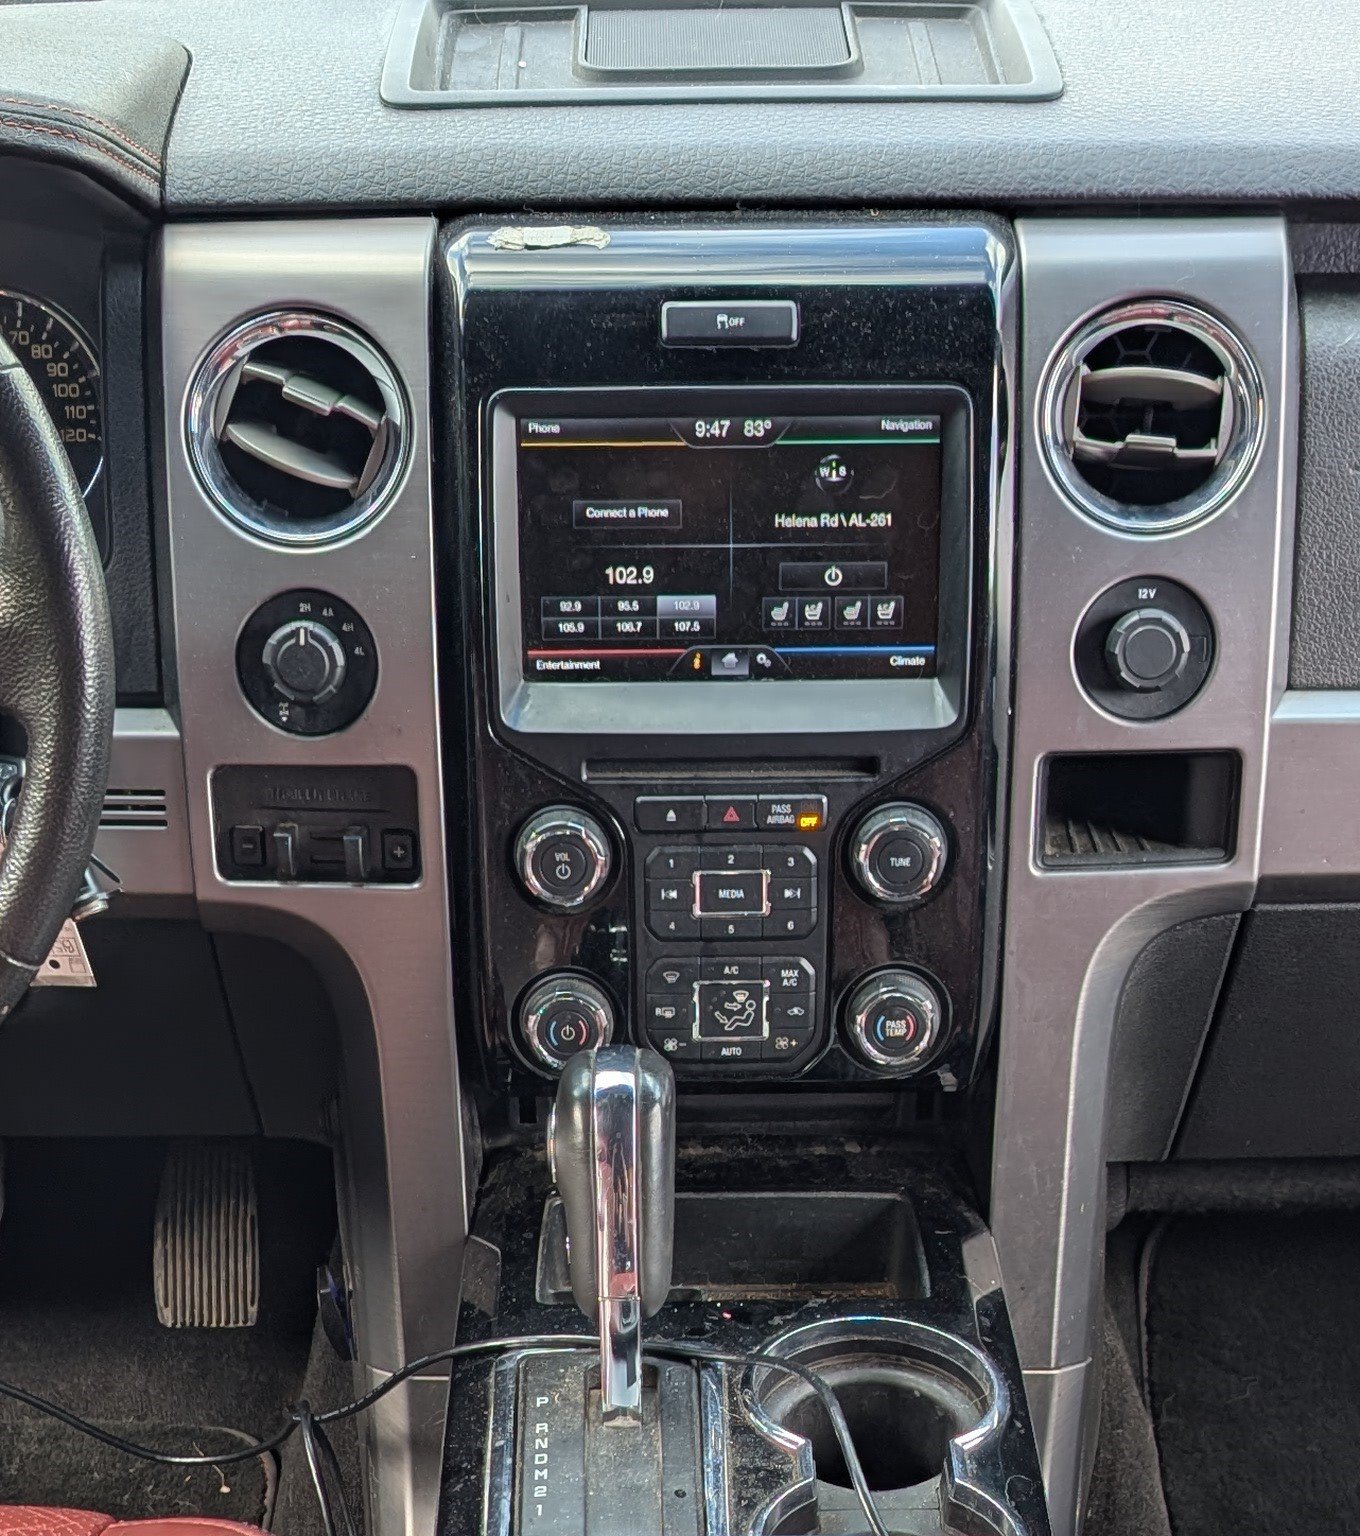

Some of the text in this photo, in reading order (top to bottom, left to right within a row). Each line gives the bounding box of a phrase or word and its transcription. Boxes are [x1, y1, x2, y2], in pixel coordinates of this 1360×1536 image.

[9, 331, 30, 346] 70
[31, 345, 52, 359] 80
[46, 363, 69, 377] 90
[52, 384, 80, 398] 100
[65, 406, 87, 419] 110
[528, 422, 560, 435] Phone
[695, 420, 730, 438] 9:47
[881, 419, 933, 433] Navigation
[60, 429, 86, 442] 120
[586, 507, 669, 519] Connect a Phone
[774, 513, 818, 528] Helena
[820, 513, 838, 528] Rd
[849, 512, 892, 527] AL-261
[605, 566, 654, 586] 102.9
[1138, 588, 1157, 599] 12V
[674, 601, 700, 611] 102.9
[536, 659, 600, 670] Entertainment
[890, 655, 925, 668] Climate
[771, 804, 792, 814] PASS
[767, 815, 795, 824] AIRBAG
[801, 816, 818, 827] OFF
[555, 852, 570, 862] VOL
[728, 855, 734, 864] 2
[788, 858, 795, 867] 3
[890, 857, 911, 867] TUNE
[669, 859, 675, 868] 1
[718, 889, 745, 899] MEDIA
[669, 922, 676, 930] 4
[728, 925, 734, 934] 5
[788, 921, 794, 930] 6
[723, 965, 739, 975] A/C
[781, 969, 799, 980] MAX
[782, 977, 798, 987] A/C
[886, 1019, 906, 1029] PASS
[885, 1026, 907, 1037] TEMP
[721, 1046, 742, 1056] AUTO
[536, 1397, 549, 1408] P
[536, 1423, 548, 1434] R
[535, 1438, 548, 1449] N
[535, 1454, 548, 1465] D
[534, 1469, 548, 1480] M
[534, 1486, 547, 1498] 2
[536, 1504, 543, 1516] 1
